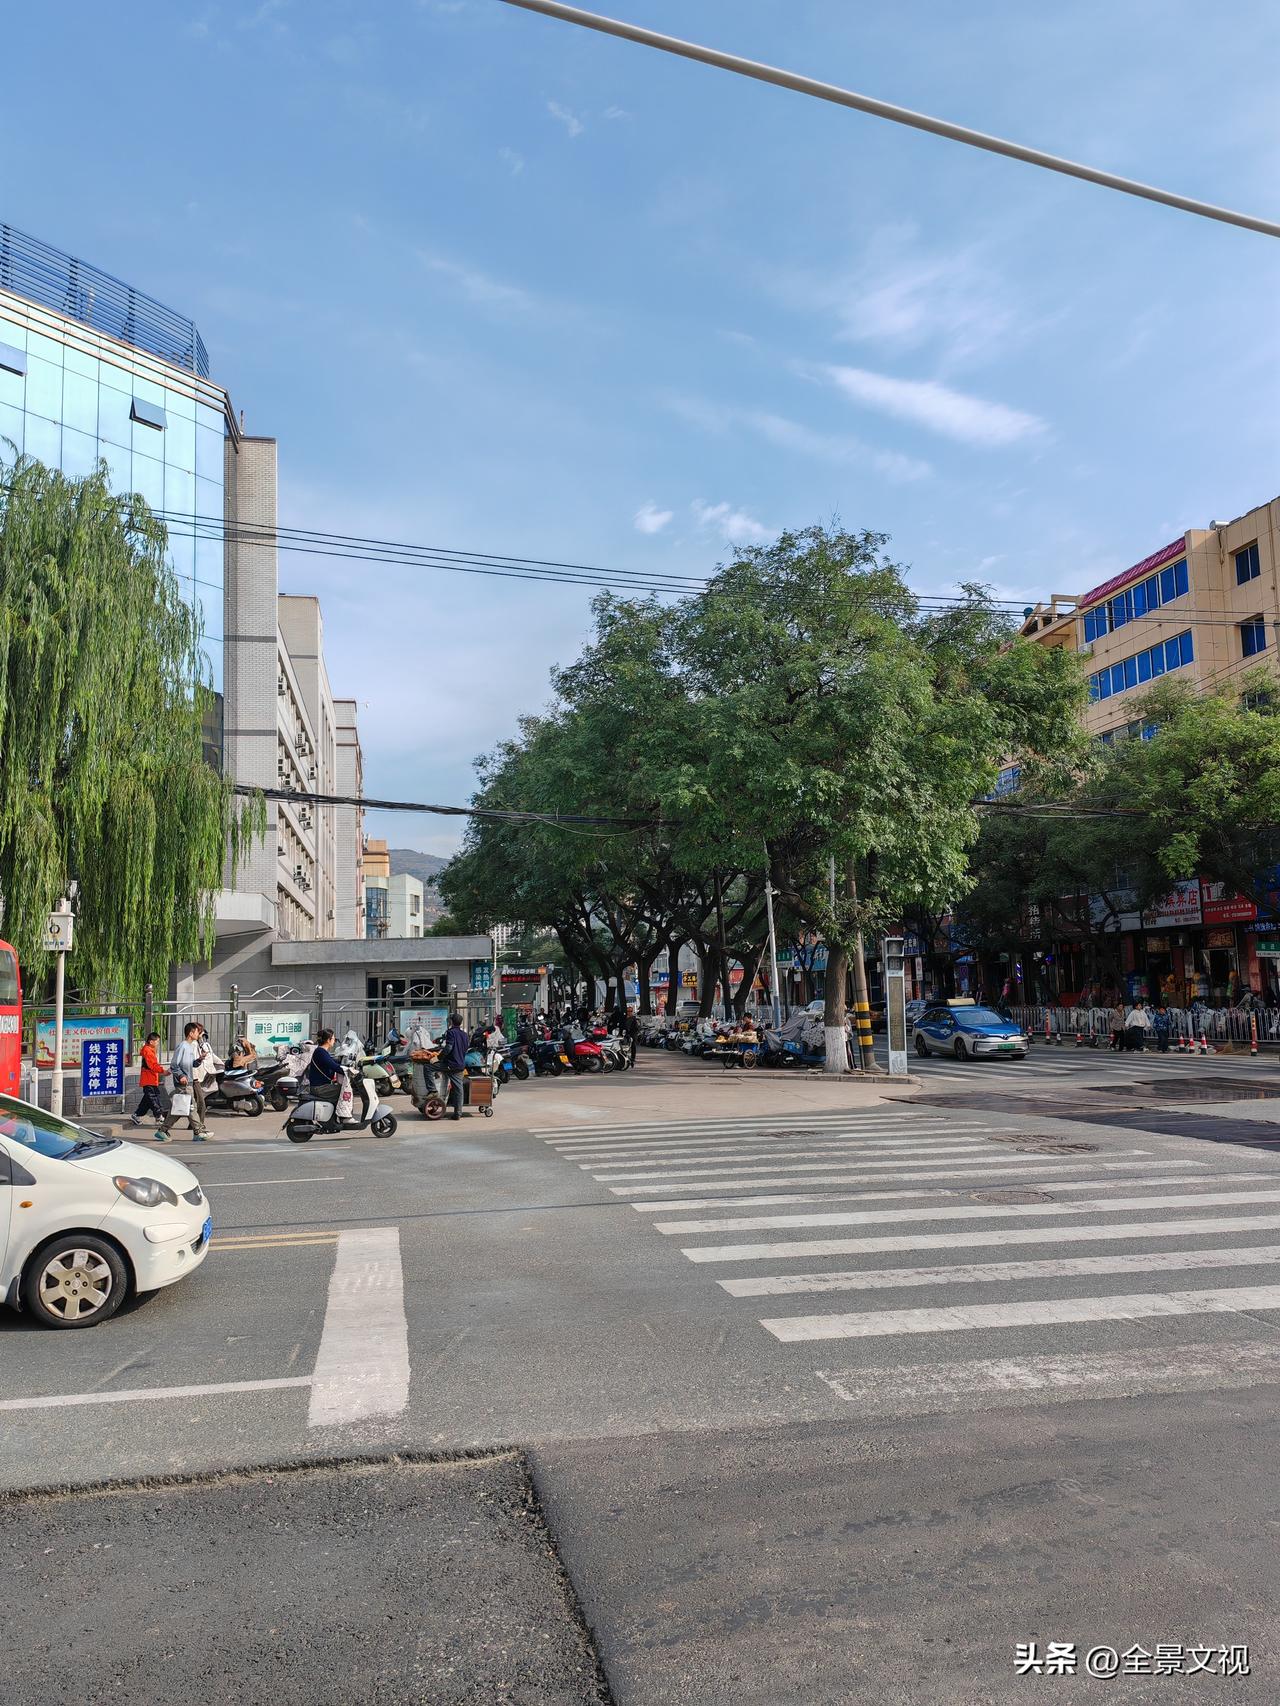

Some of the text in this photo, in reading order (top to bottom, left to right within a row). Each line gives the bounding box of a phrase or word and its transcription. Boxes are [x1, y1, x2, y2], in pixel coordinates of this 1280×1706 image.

[1027, 903, 1042, 941] 招待所
[48, 1025, 120, 1037] 社主义核心价值观
[254, 1021, 303, 1034] 急诊 门诊部
[88, 1043, 102, 1090] 线外禁停
[105, 1042, 119, 1089] 违者拖离
